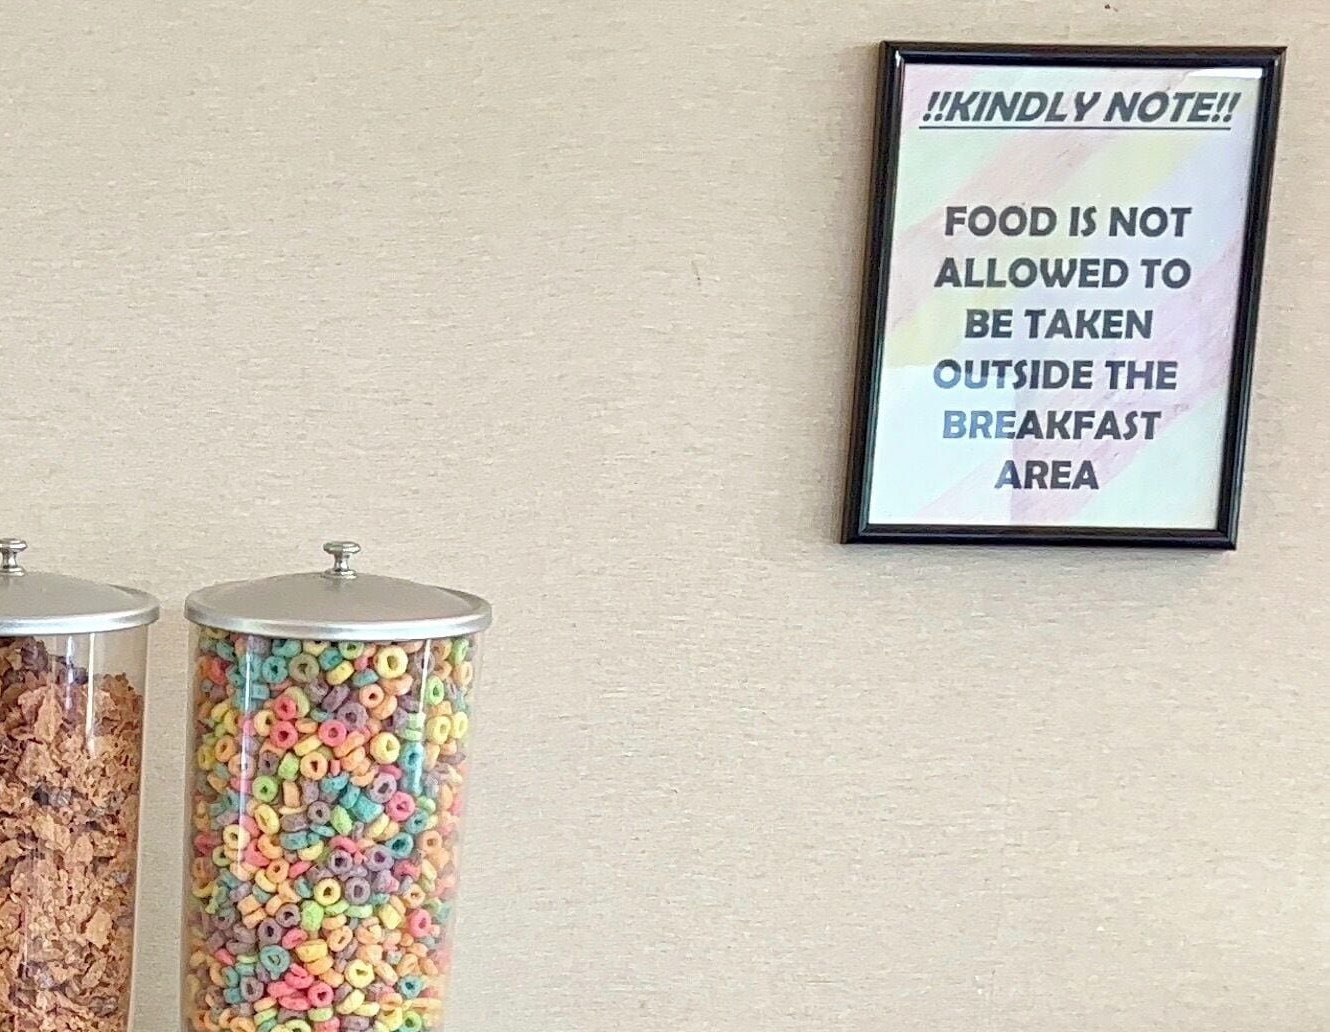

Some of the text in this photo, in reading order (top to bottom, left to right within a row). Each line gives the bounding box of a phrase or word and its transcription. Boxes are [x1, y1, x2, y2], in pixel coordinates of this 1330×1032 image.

[922, 91, 1242, 123] !!KINDLY NOTE!!
[945, 206, 1192, 238] FOOD IS NOT
[934, 257, 1191, 288] ALLOWED TO
[964, 309, 1153, 339] BE TAKEN
[933, 359, 1178, 390] OUTSIDE THE
[942, 410, 1161, 440] BREAKFAST
[995, 460, 1099, 489] AREA
